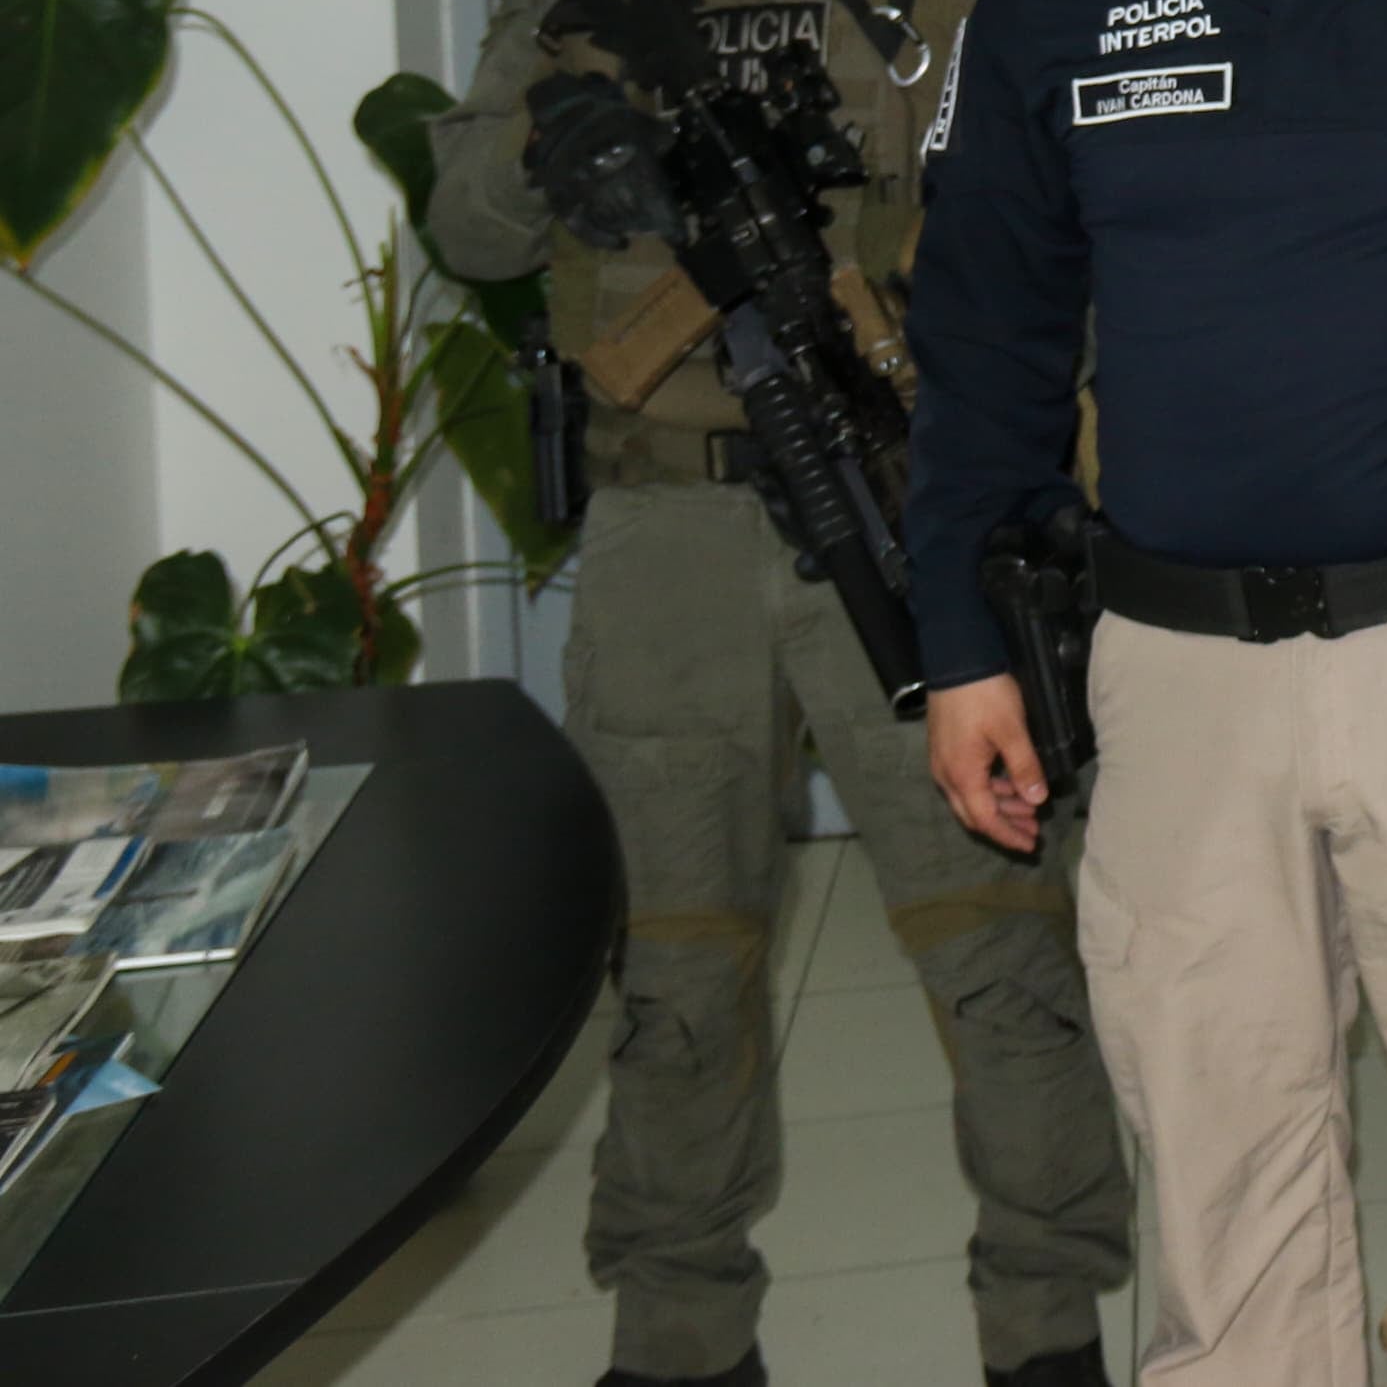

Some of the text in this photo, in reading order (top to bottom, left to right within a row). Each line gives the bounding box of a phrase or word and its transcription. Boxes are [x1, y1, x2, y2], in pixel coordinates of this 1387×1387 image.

[1099, 14, 1222, 55] INTERPOL
[1118, 73, 1178, 95] Capitán
[1129, 87, 1205, 110] CARDONA
